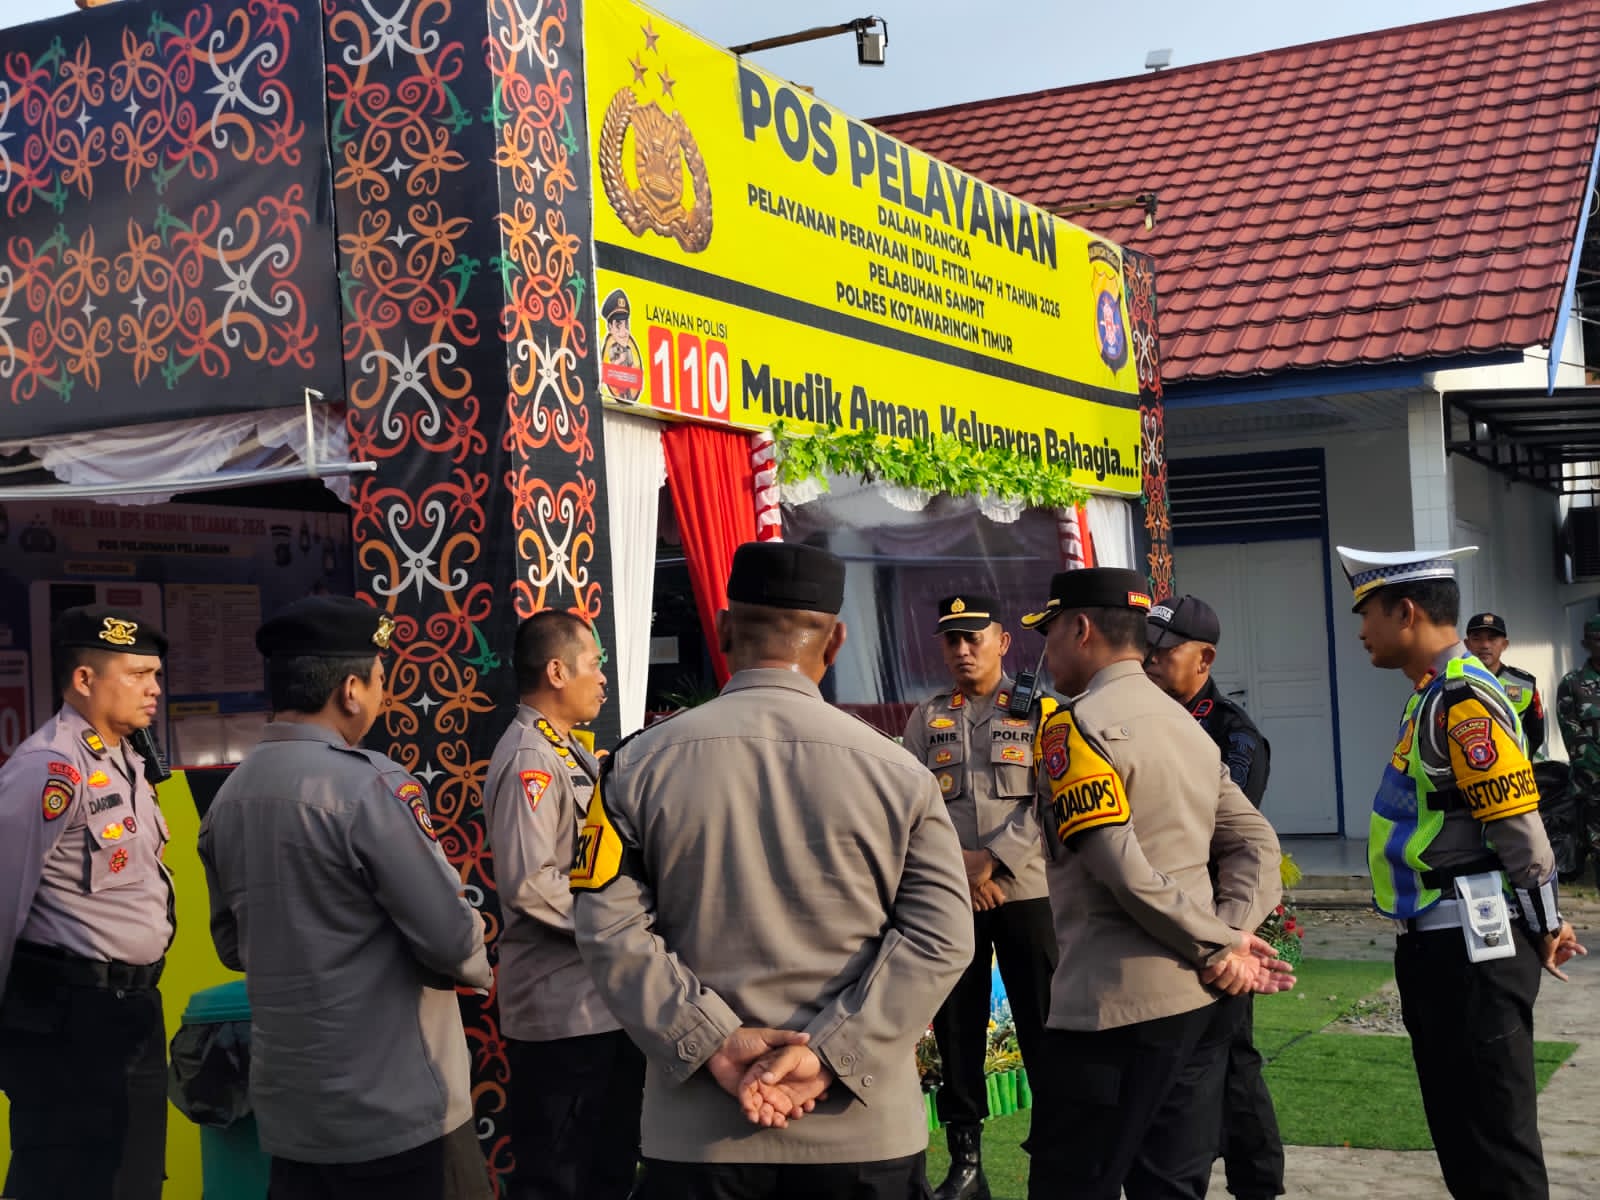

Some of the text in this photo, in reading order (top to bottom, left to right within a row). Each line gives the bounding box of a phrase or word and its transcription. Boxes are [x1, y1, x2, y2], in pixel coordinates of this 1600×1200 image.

[738, 64, 1057, 270] POS PELAYANAN
[747, 183, 1061, 319] PELAYANAN PERAYAAN IDUL FITRI 1447 H TAHUN 2026
[877, 205, 972, 260] DALAM RANGKA
[645, 303, 728, 340] LAYANAN POLISI
[836, 281, 1014, 354] POLRES KOTAWARINGIN TIMUR
[869, 261, 985, 319] PELABUHAN SAMPIT
[653, 338, 729, 414] 110
[741, 358, 844, 428] Mudik
[930, 732, 957, 744] ANIS
[993, 731, 1034, 744] POLRI
